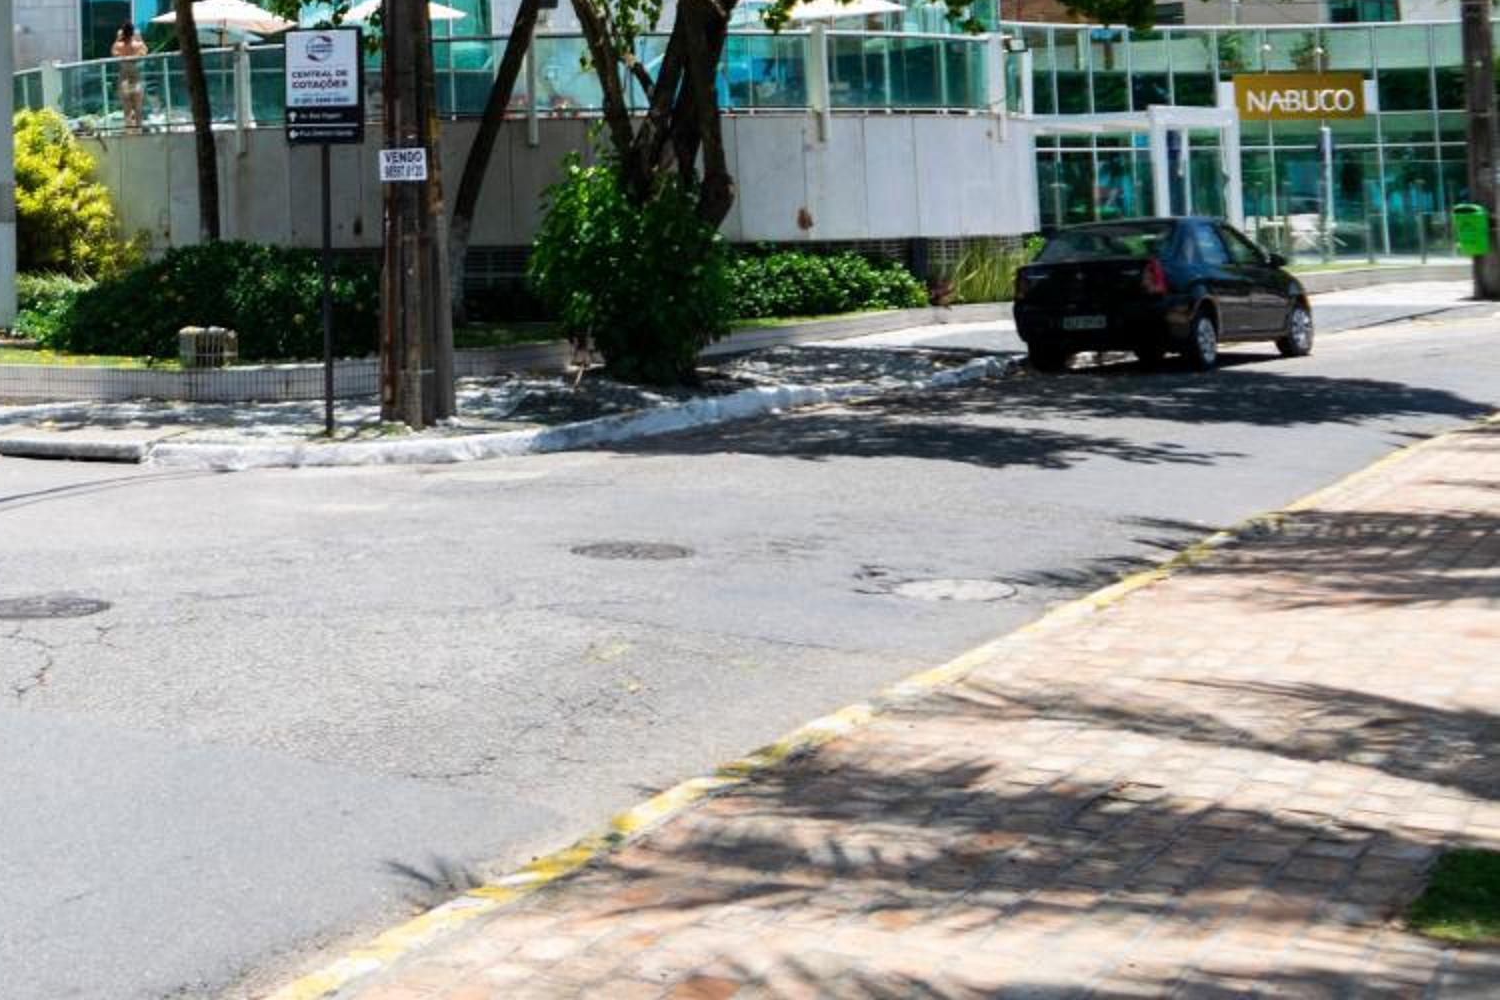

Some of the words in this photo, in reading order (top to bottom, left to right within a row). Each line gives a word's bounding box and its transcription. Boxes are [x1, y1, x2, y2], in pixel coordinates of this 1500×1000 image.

[291, 70, 332, 78] CENTRAL
[335, 69, 348, 77] DE
[291, 78, 348, 90] COTAÇÕES
[1246, 89, 1355, 113] NABUCO
[383, 151, 423, 163] VENDO
